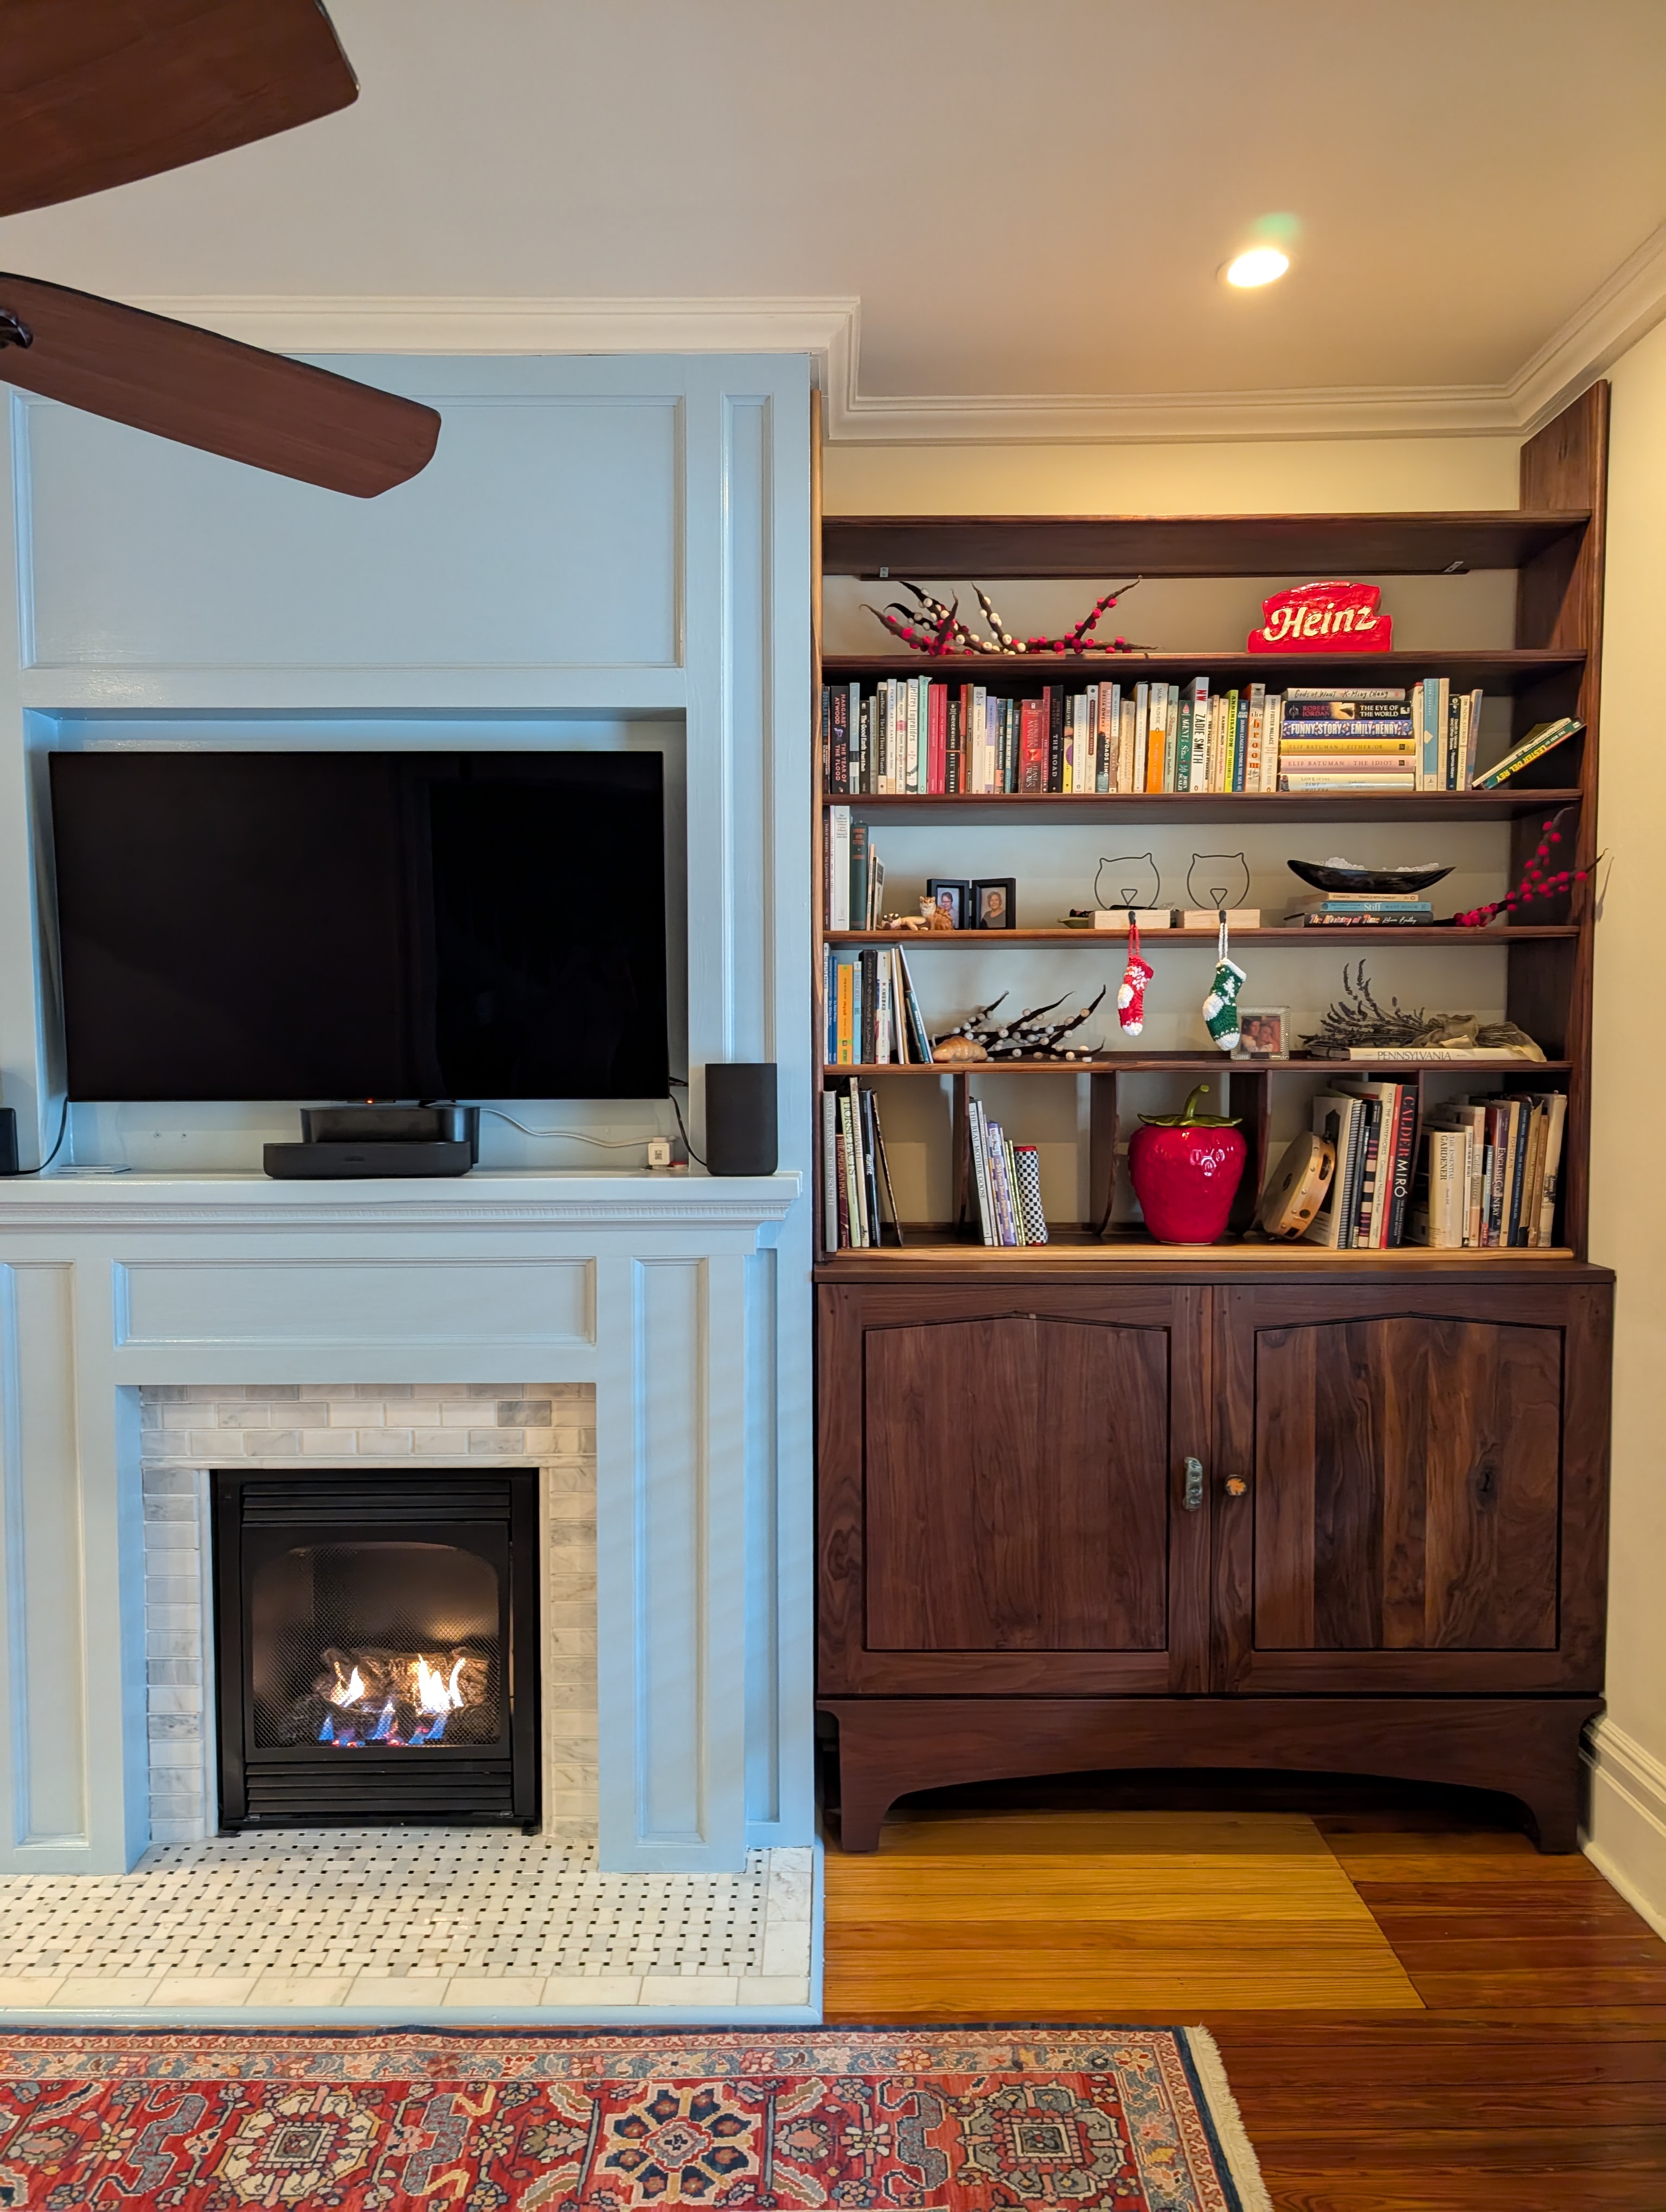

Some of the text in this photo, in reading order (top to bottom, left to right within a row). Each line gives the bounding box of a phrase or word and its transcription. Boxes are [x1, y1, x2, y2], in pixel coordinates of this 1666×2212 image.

[1263, 603, 1377, 641] Heinz
[908, 685, 918, 742] Jeffrey Eugenides
[1167, 716, 1175, 736] Shame
[1182, 718, 1190, 738] AGENT
[1193, 689, 1207, 764] NW ZADIE SMITH
[1291, 723, 1398, 734] FUNNY STORY EMILY HENRY
[842, 774, 846, 783] OF
[1496, 745, 1547, 783] LESTER DEL REY
[1309, 915, 1322, 924] The
[1323, 915, 1352, 926] Ministry
[1362, 914, 1380, 924] Time
[1377, 1051, 1452, 1060] PENNSYLVANIA
[843, 1100, 853, 1139] HORSE
[1381, 1118, 1390, 1155] MASTERWORKS
[846, 1141, 855, 1175] FACTS
[974, 1146, 982, 1175] MOTHER
[1394, 1096, 1415, 1197] CALDER MIRÓ
[1492, 1147, 1506, 1217] ENGLISH COUNTRY
